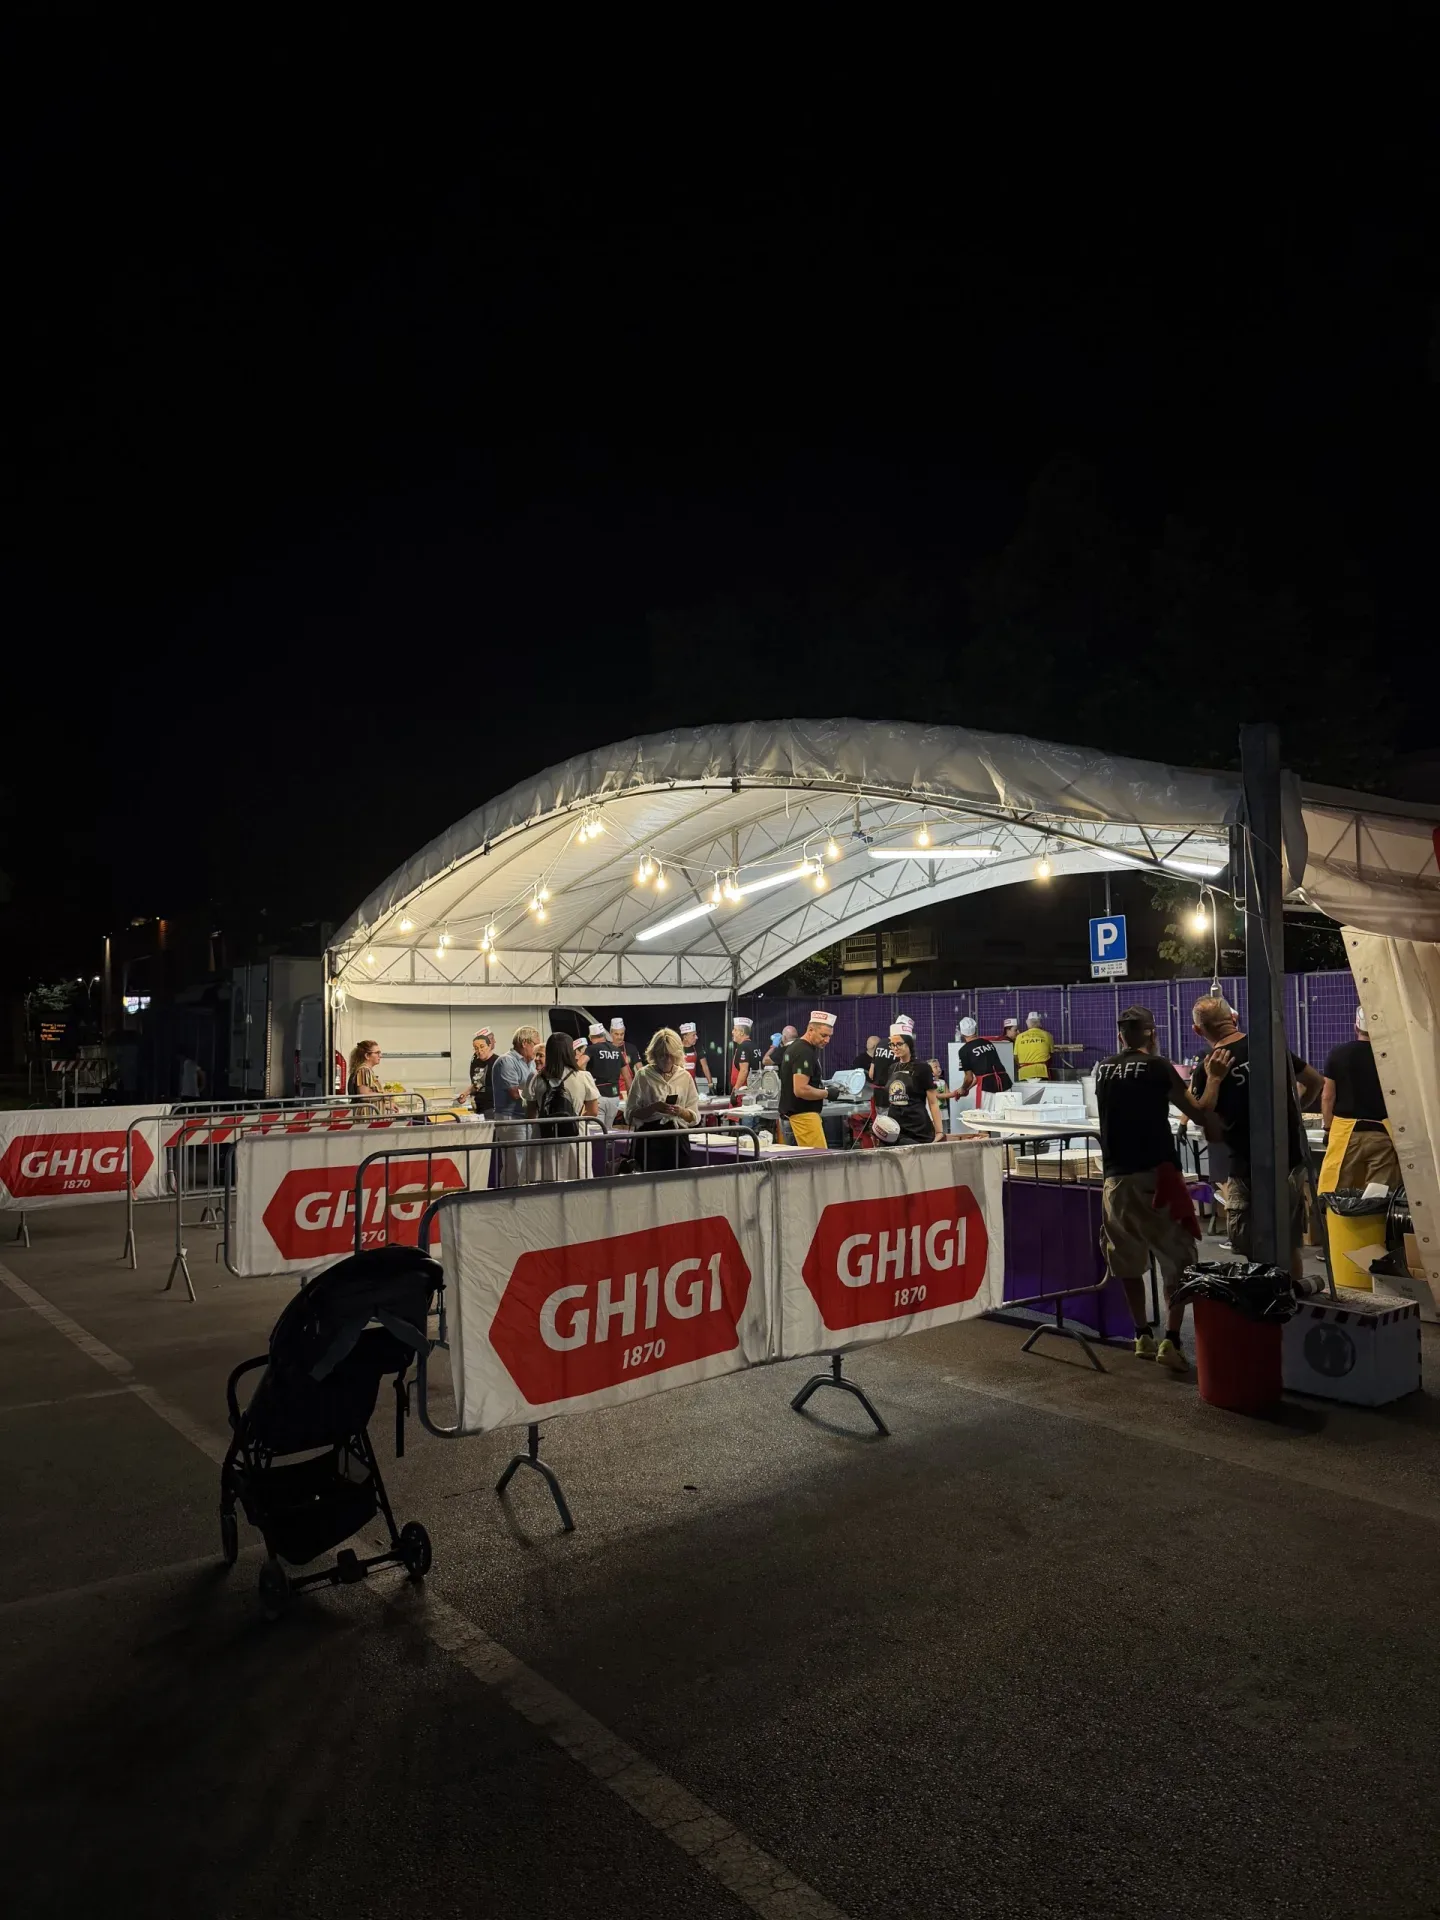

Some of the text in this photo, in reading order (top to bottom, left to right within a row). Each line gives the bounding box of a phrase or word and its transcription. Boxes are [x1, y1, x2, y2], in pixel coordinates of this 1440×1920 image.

[1097, 922, 1119, 957] P
[599, 1050, 620, 1060] STAFF
[1097, 1061, 1148, 1082] STAFF
[62, 1179, 91, 1189] 1870
[894, 1285, 927, 1307] 1870
[622, 1338, 666, 1370] 1870
